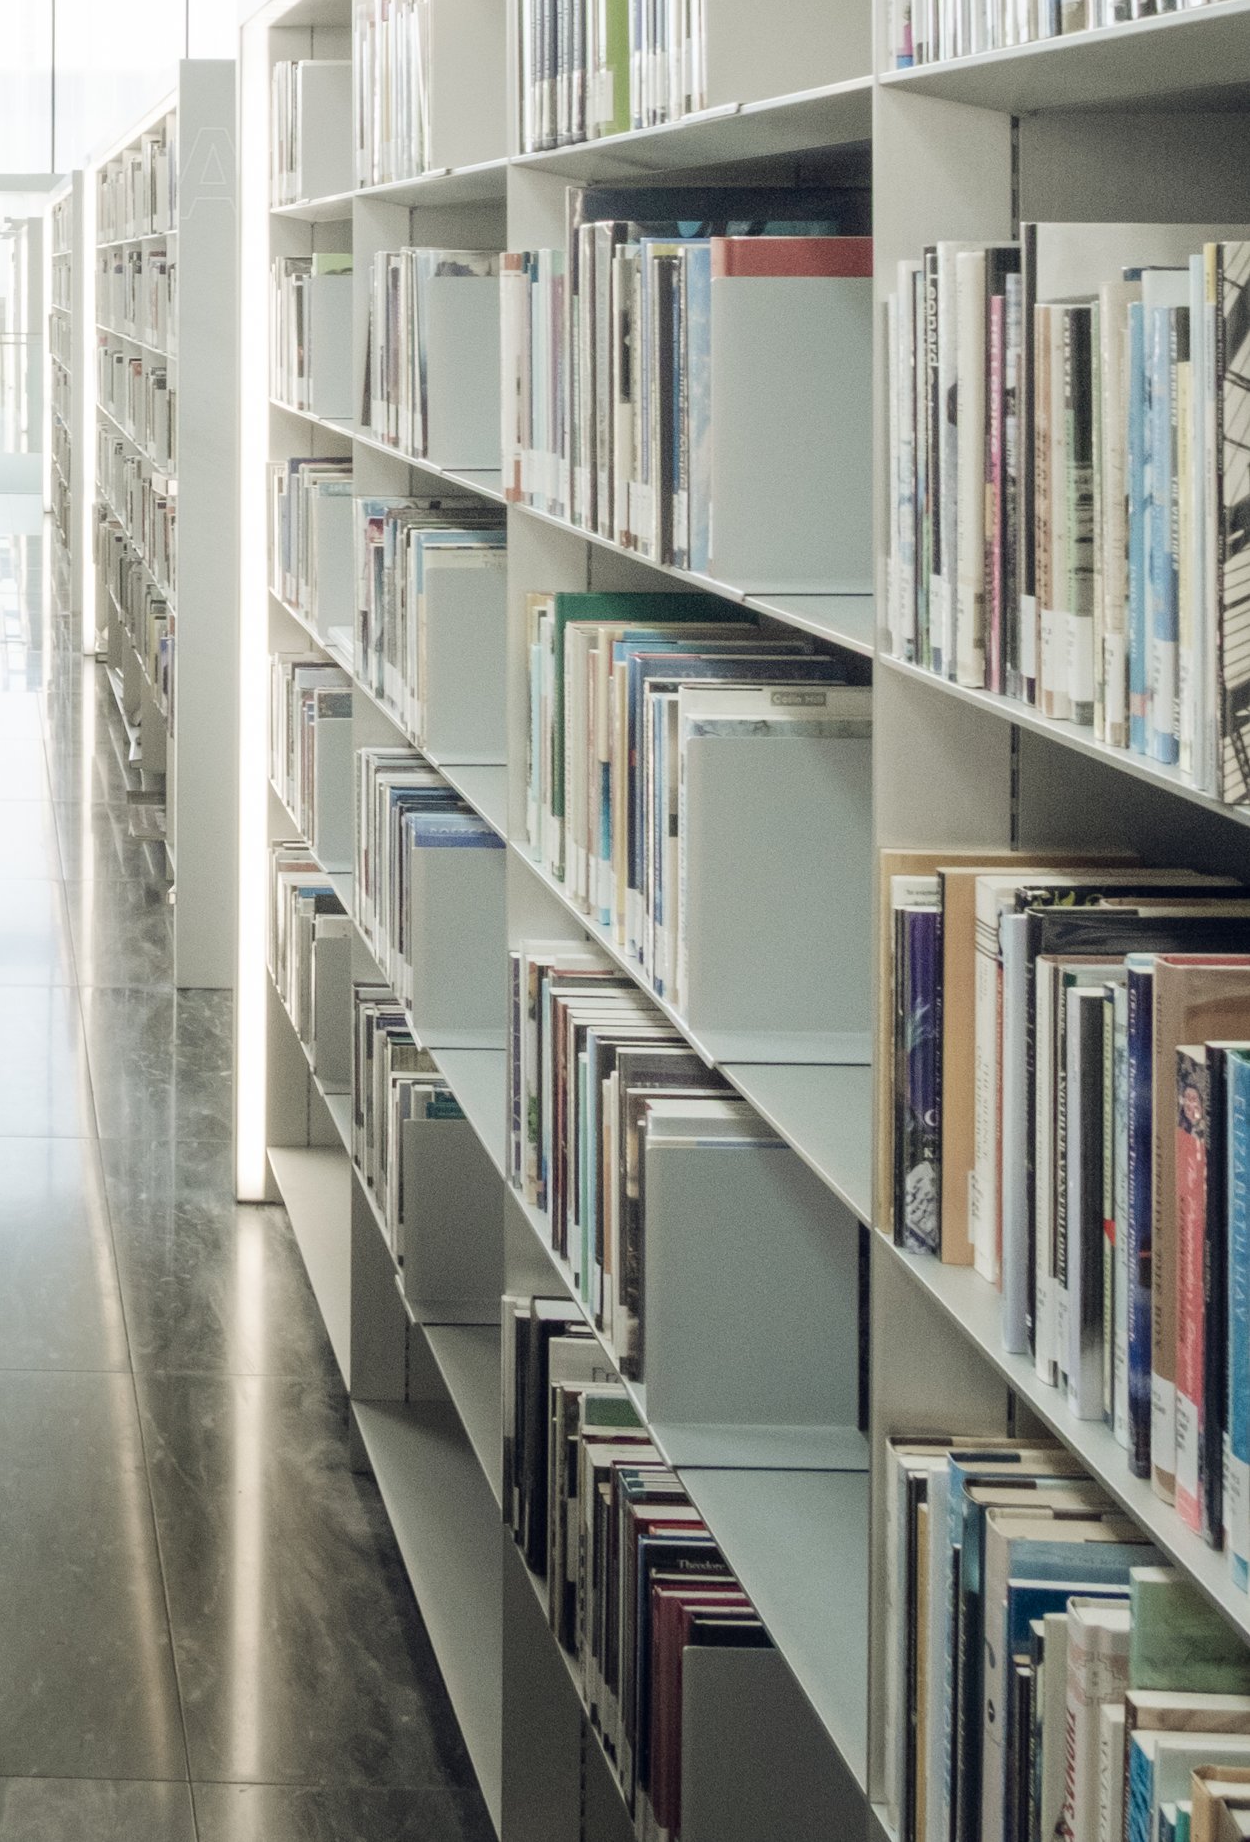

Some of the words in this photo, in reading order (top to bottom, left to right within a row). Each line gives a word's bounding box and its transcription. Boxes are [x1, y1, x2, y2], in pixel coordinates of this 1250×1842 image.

[926, 274, 939, 367] Leonard
[1059, 1068, 1067, 1153] ANOTHER
[1128, 1089, 1138, 1147] Science
[1128, 1150, 1138, 1205] Fiction
[1234, 1094, 1247, 1255] ELIZABETH
[1234, 1261, 1247, 1323] HAY
